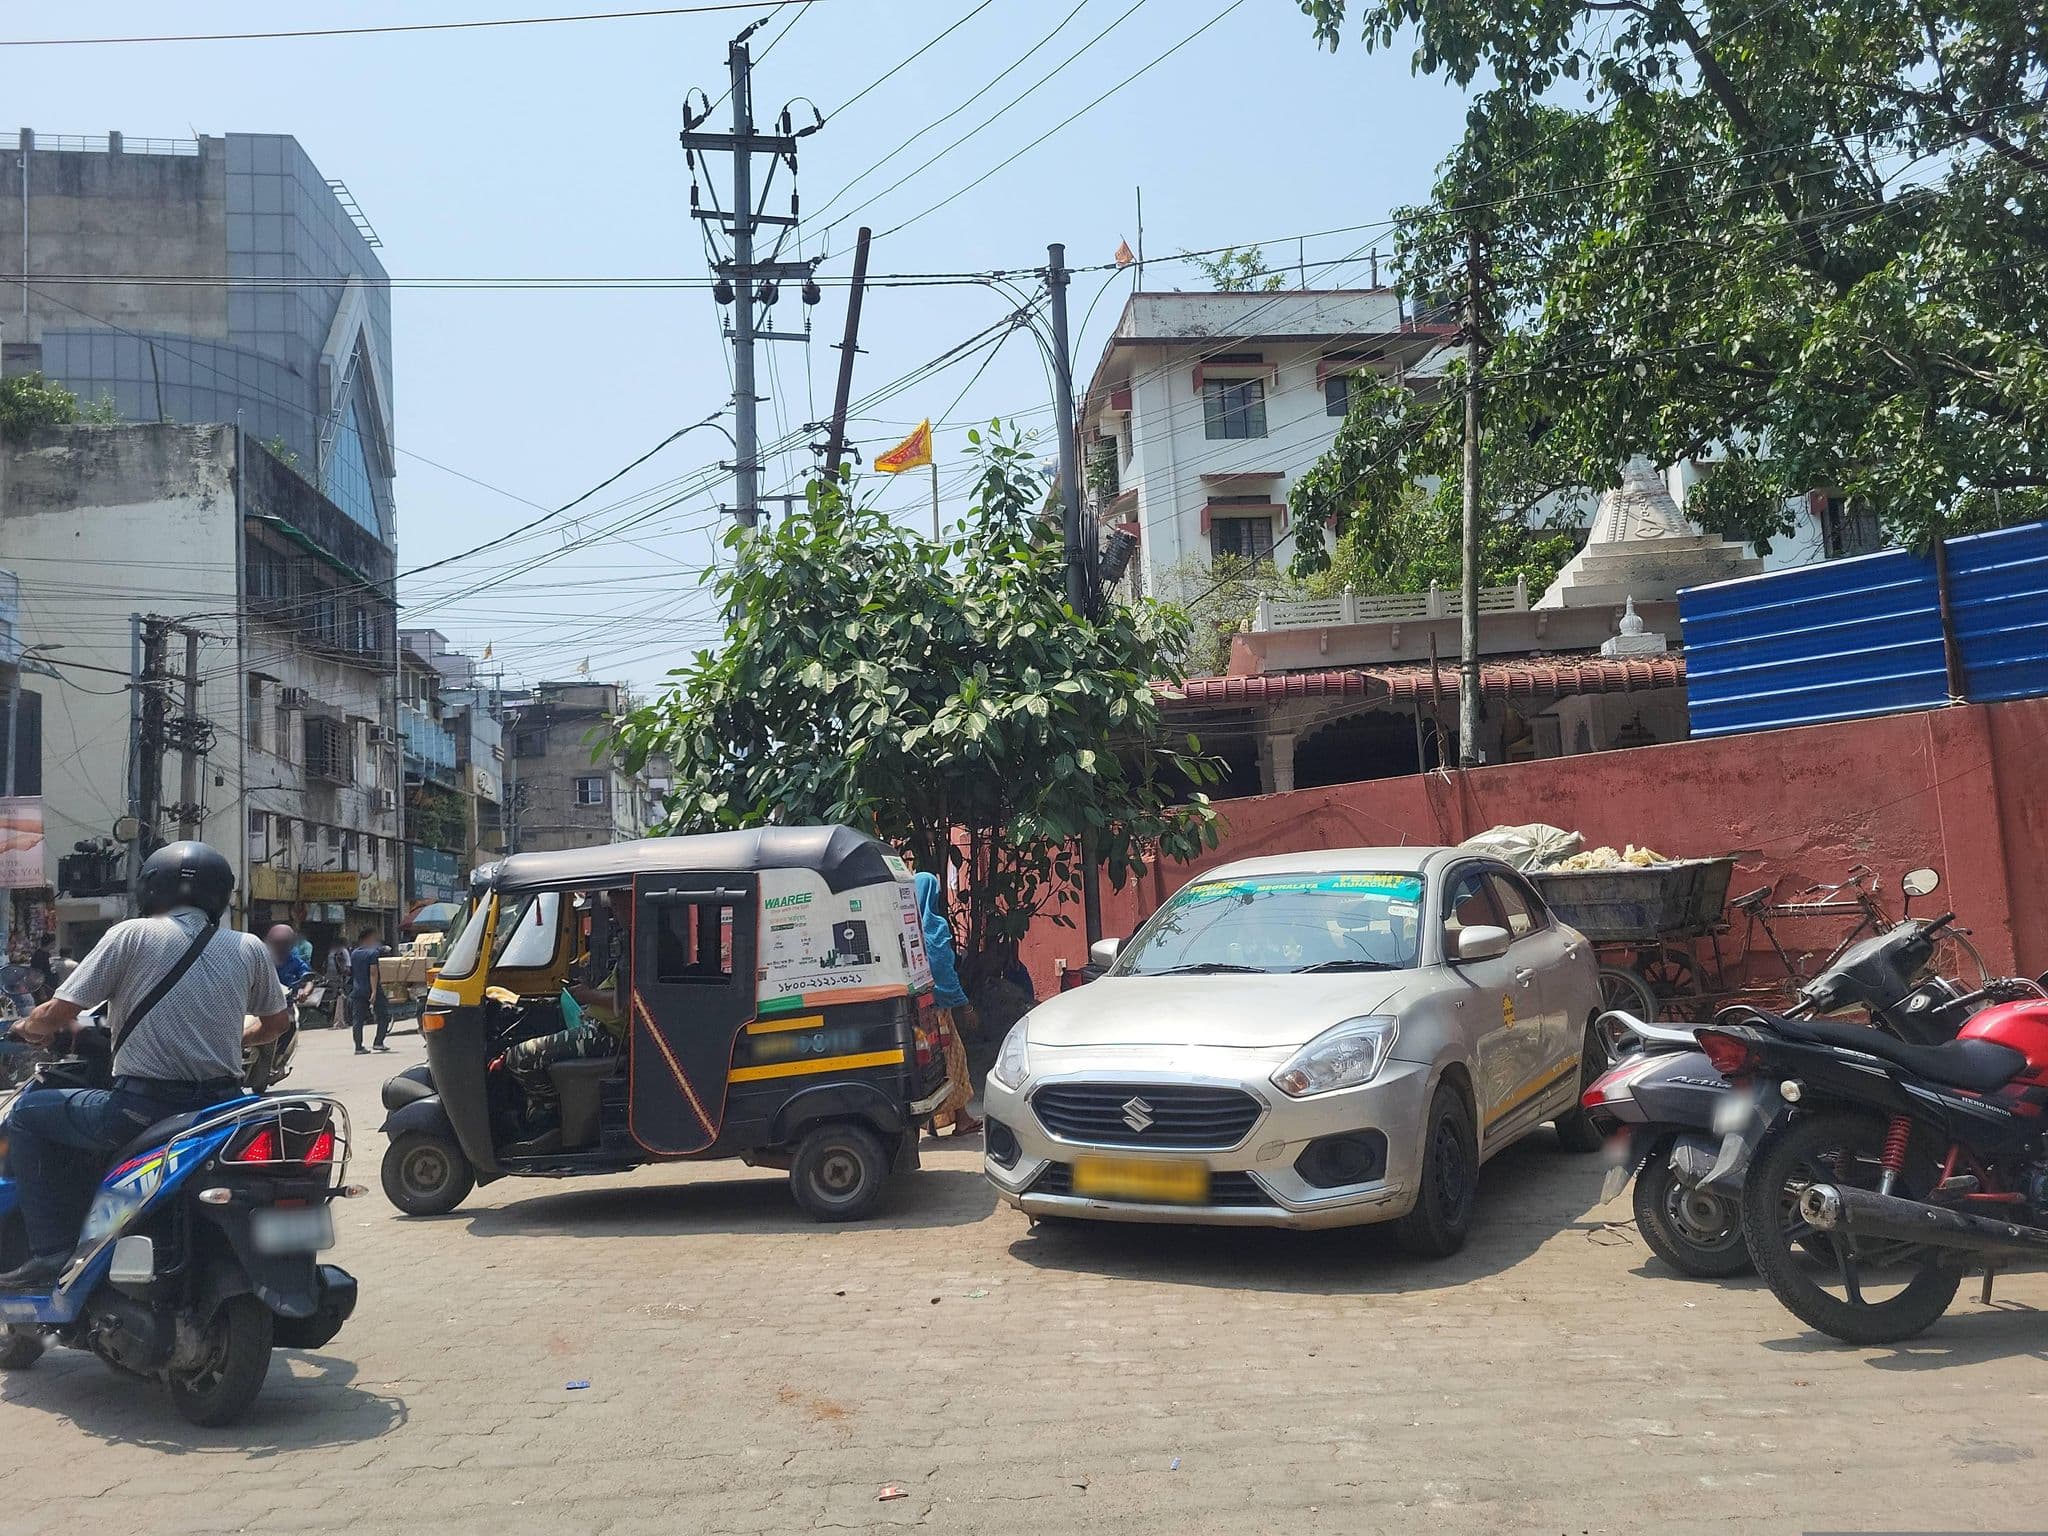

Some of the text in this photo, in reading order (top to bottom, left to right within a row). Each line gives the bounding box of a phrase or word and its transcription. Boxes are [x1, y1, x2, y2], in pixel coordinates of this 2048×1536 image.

[764, 892, 813, 910] WAAREE
[1962, 1096, 2012, 1117] HERO HONDA
